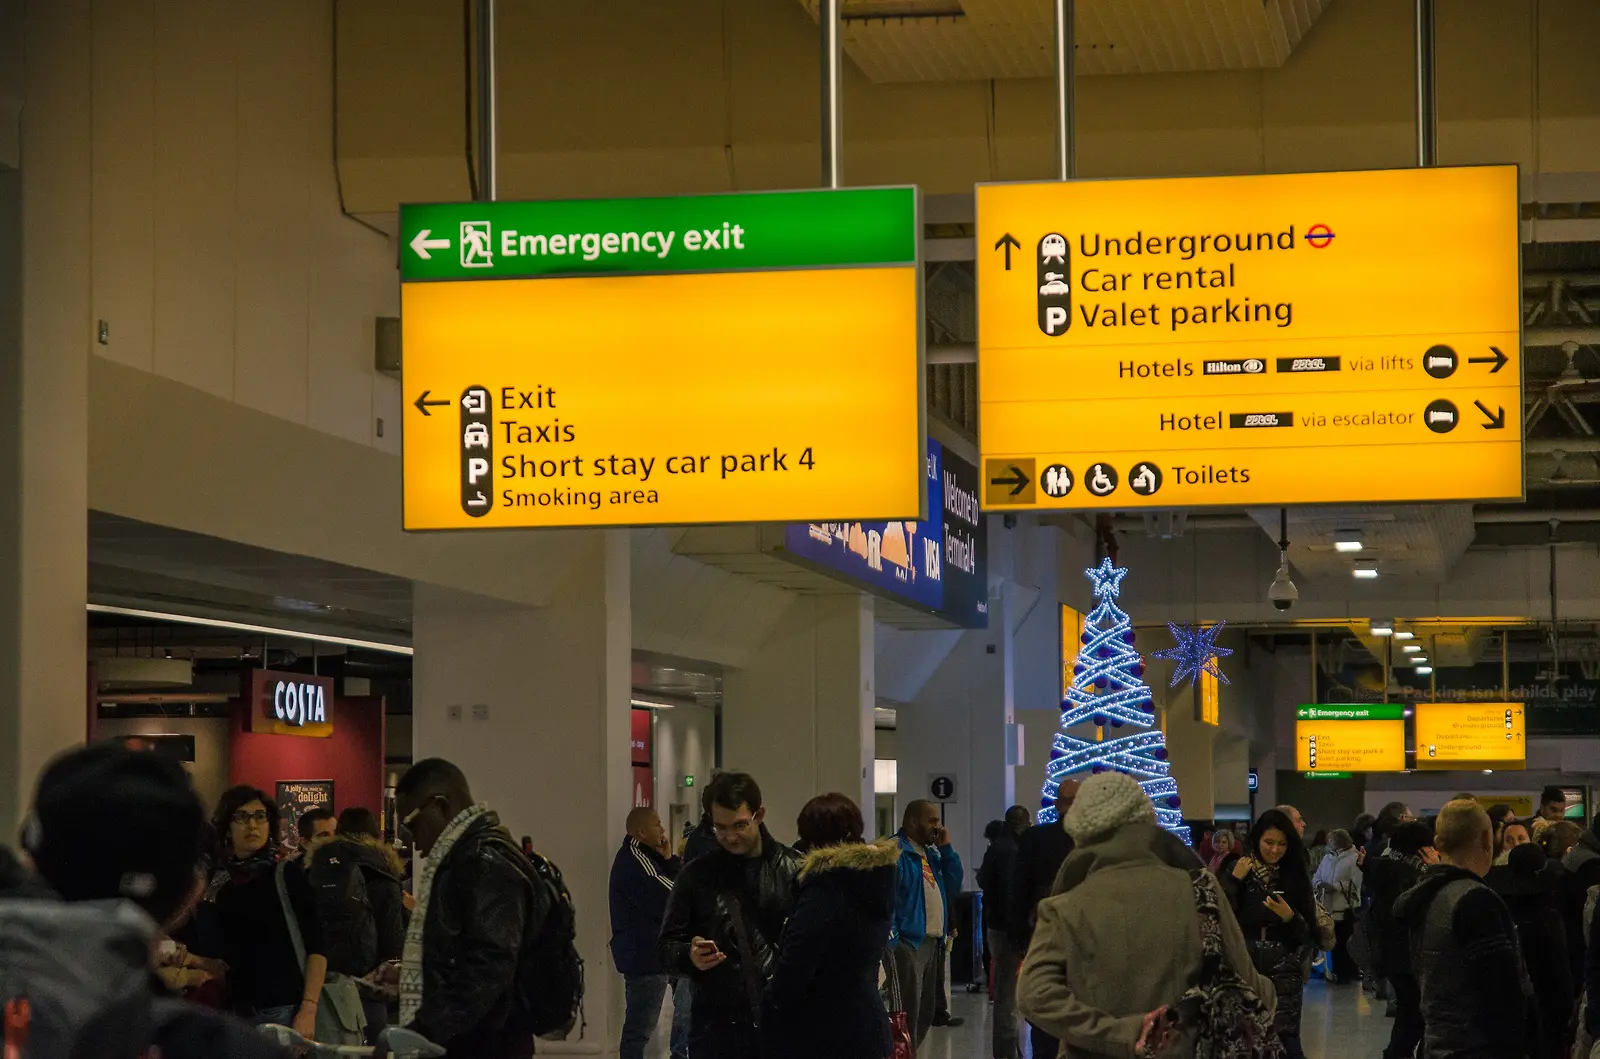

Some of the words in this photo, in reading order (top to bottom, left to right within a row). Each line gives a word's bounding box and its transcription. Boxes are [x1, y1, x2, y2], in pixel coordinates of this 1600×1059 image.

[501, 228, 674, 260] Emergency
[684, 223, 745, 251] exit
[1080, 226, 1295, 262] Underground
[1081, 269, 1132, 293] Car
[1143, 265, 1235, 291] rental
[1081, 301, 1160, 328] Valet
[1171, 298, 1293, 331] parking
[1119, 359, 1193, 379] Hotels
[1207, 361, 1242, 373] Hilton
[1349, 358, 1374, 371] via
[1381, 355, 1414, 370] lifts
[501, 385, 556, 410] Exit
[501, 420, 575, 444] Taxis
[1159, 411, 1223, 432] Hotel
[1302, 413, 1326, 427] via
[1333, 411, 1415, 426] escalator
[502, 454, 583, 480] Short
[594, 454, 655, 482] stay
[666, 454, 710, 475] car
[721, 447, 789, 479] park
[799, 447, 816, 471] 4
[1172, 465, 1251, 485] Toilets
[502, 488, 602, 510] Smoking
[609, 489, 659, 506] area
[943, 470, 972, 524] Welcome
[971, 489, 979, 526] to
[924, 536, 941, 581] VISA
[944, 522, 971, 573] Terminal
[970, 537, 976, 575] 4
[273, 680, 326, 726] COSTA
[1402, 685, 1468, 701] Packing
[1563, 683, 1597, 703] play
[1317, 709, 1355, 718] Emergency
[290, 784, 302, 793] jolly
[298, 791, 329, 804] delight
